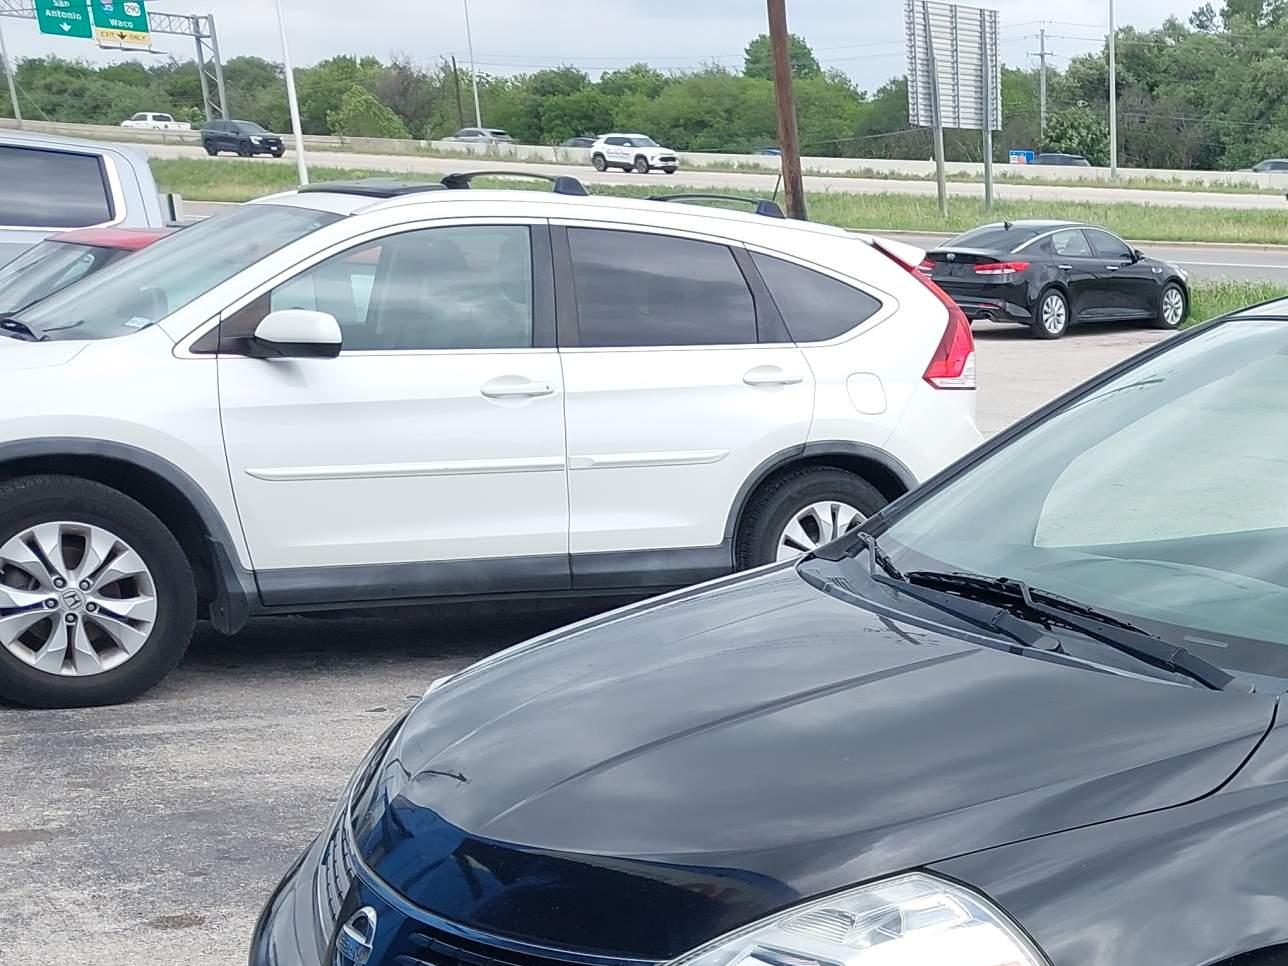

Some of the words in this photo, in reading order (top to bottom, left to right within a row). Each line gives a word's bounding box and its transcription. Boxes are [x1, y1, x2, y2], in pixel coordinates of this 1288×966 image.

[45, 9, 82, 20] Antonio
[125, 4, 140, 14] 290
[109, 18, 134, 29] Waco
